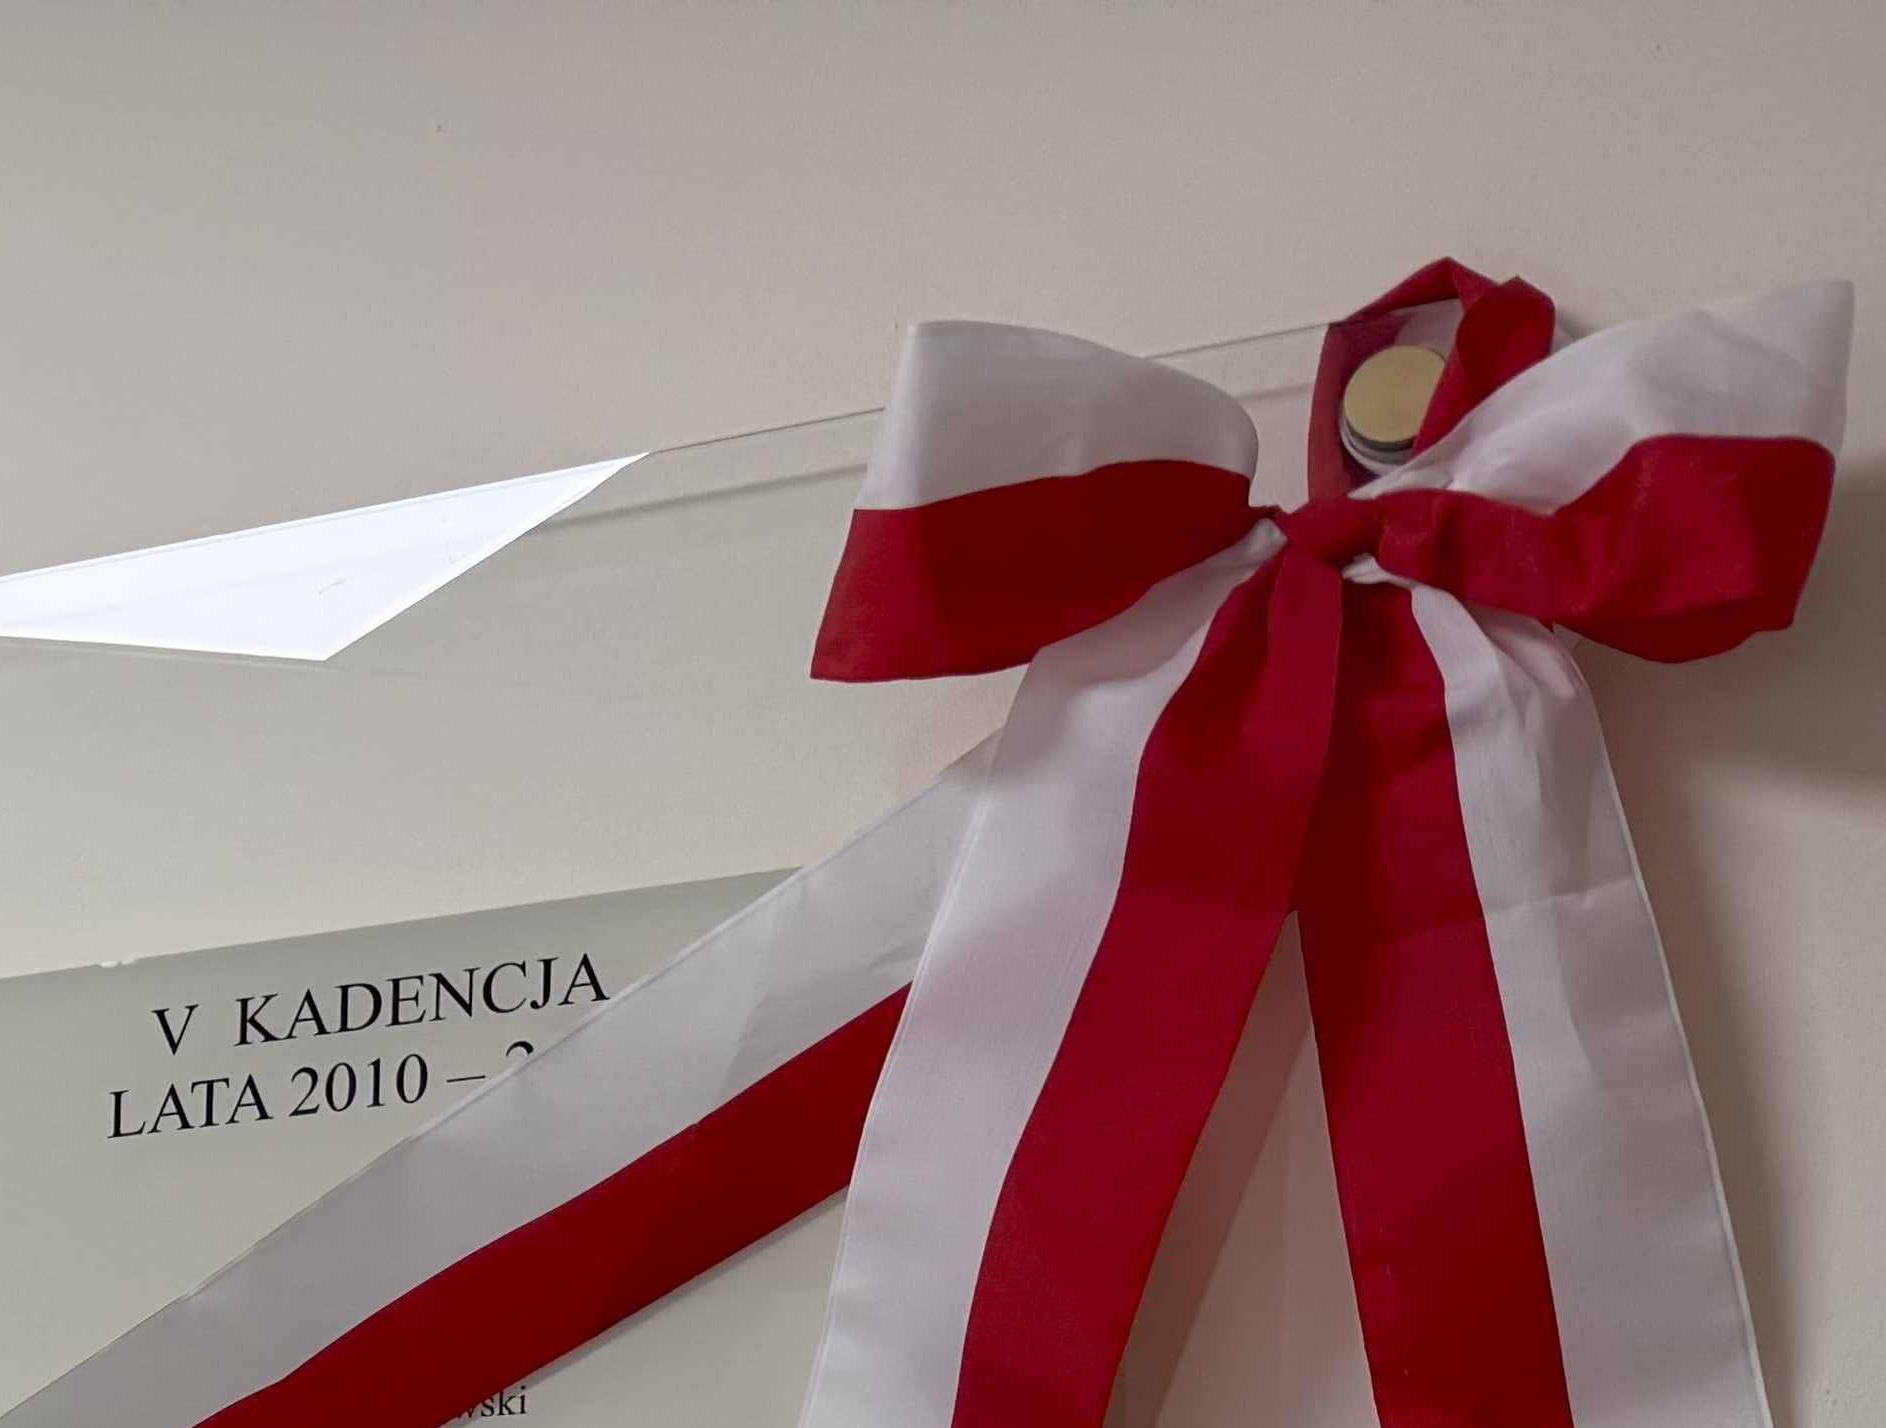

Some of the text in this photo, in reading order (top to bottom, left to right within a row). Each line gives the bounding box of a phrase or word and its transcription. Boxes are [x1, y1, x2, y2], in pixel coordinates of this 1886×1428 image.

[151, 953, 611, 1055] V KADENCJA
[107, 1074, 274, 1139] LATA
[289, 1053, 428, 1117] 2010
